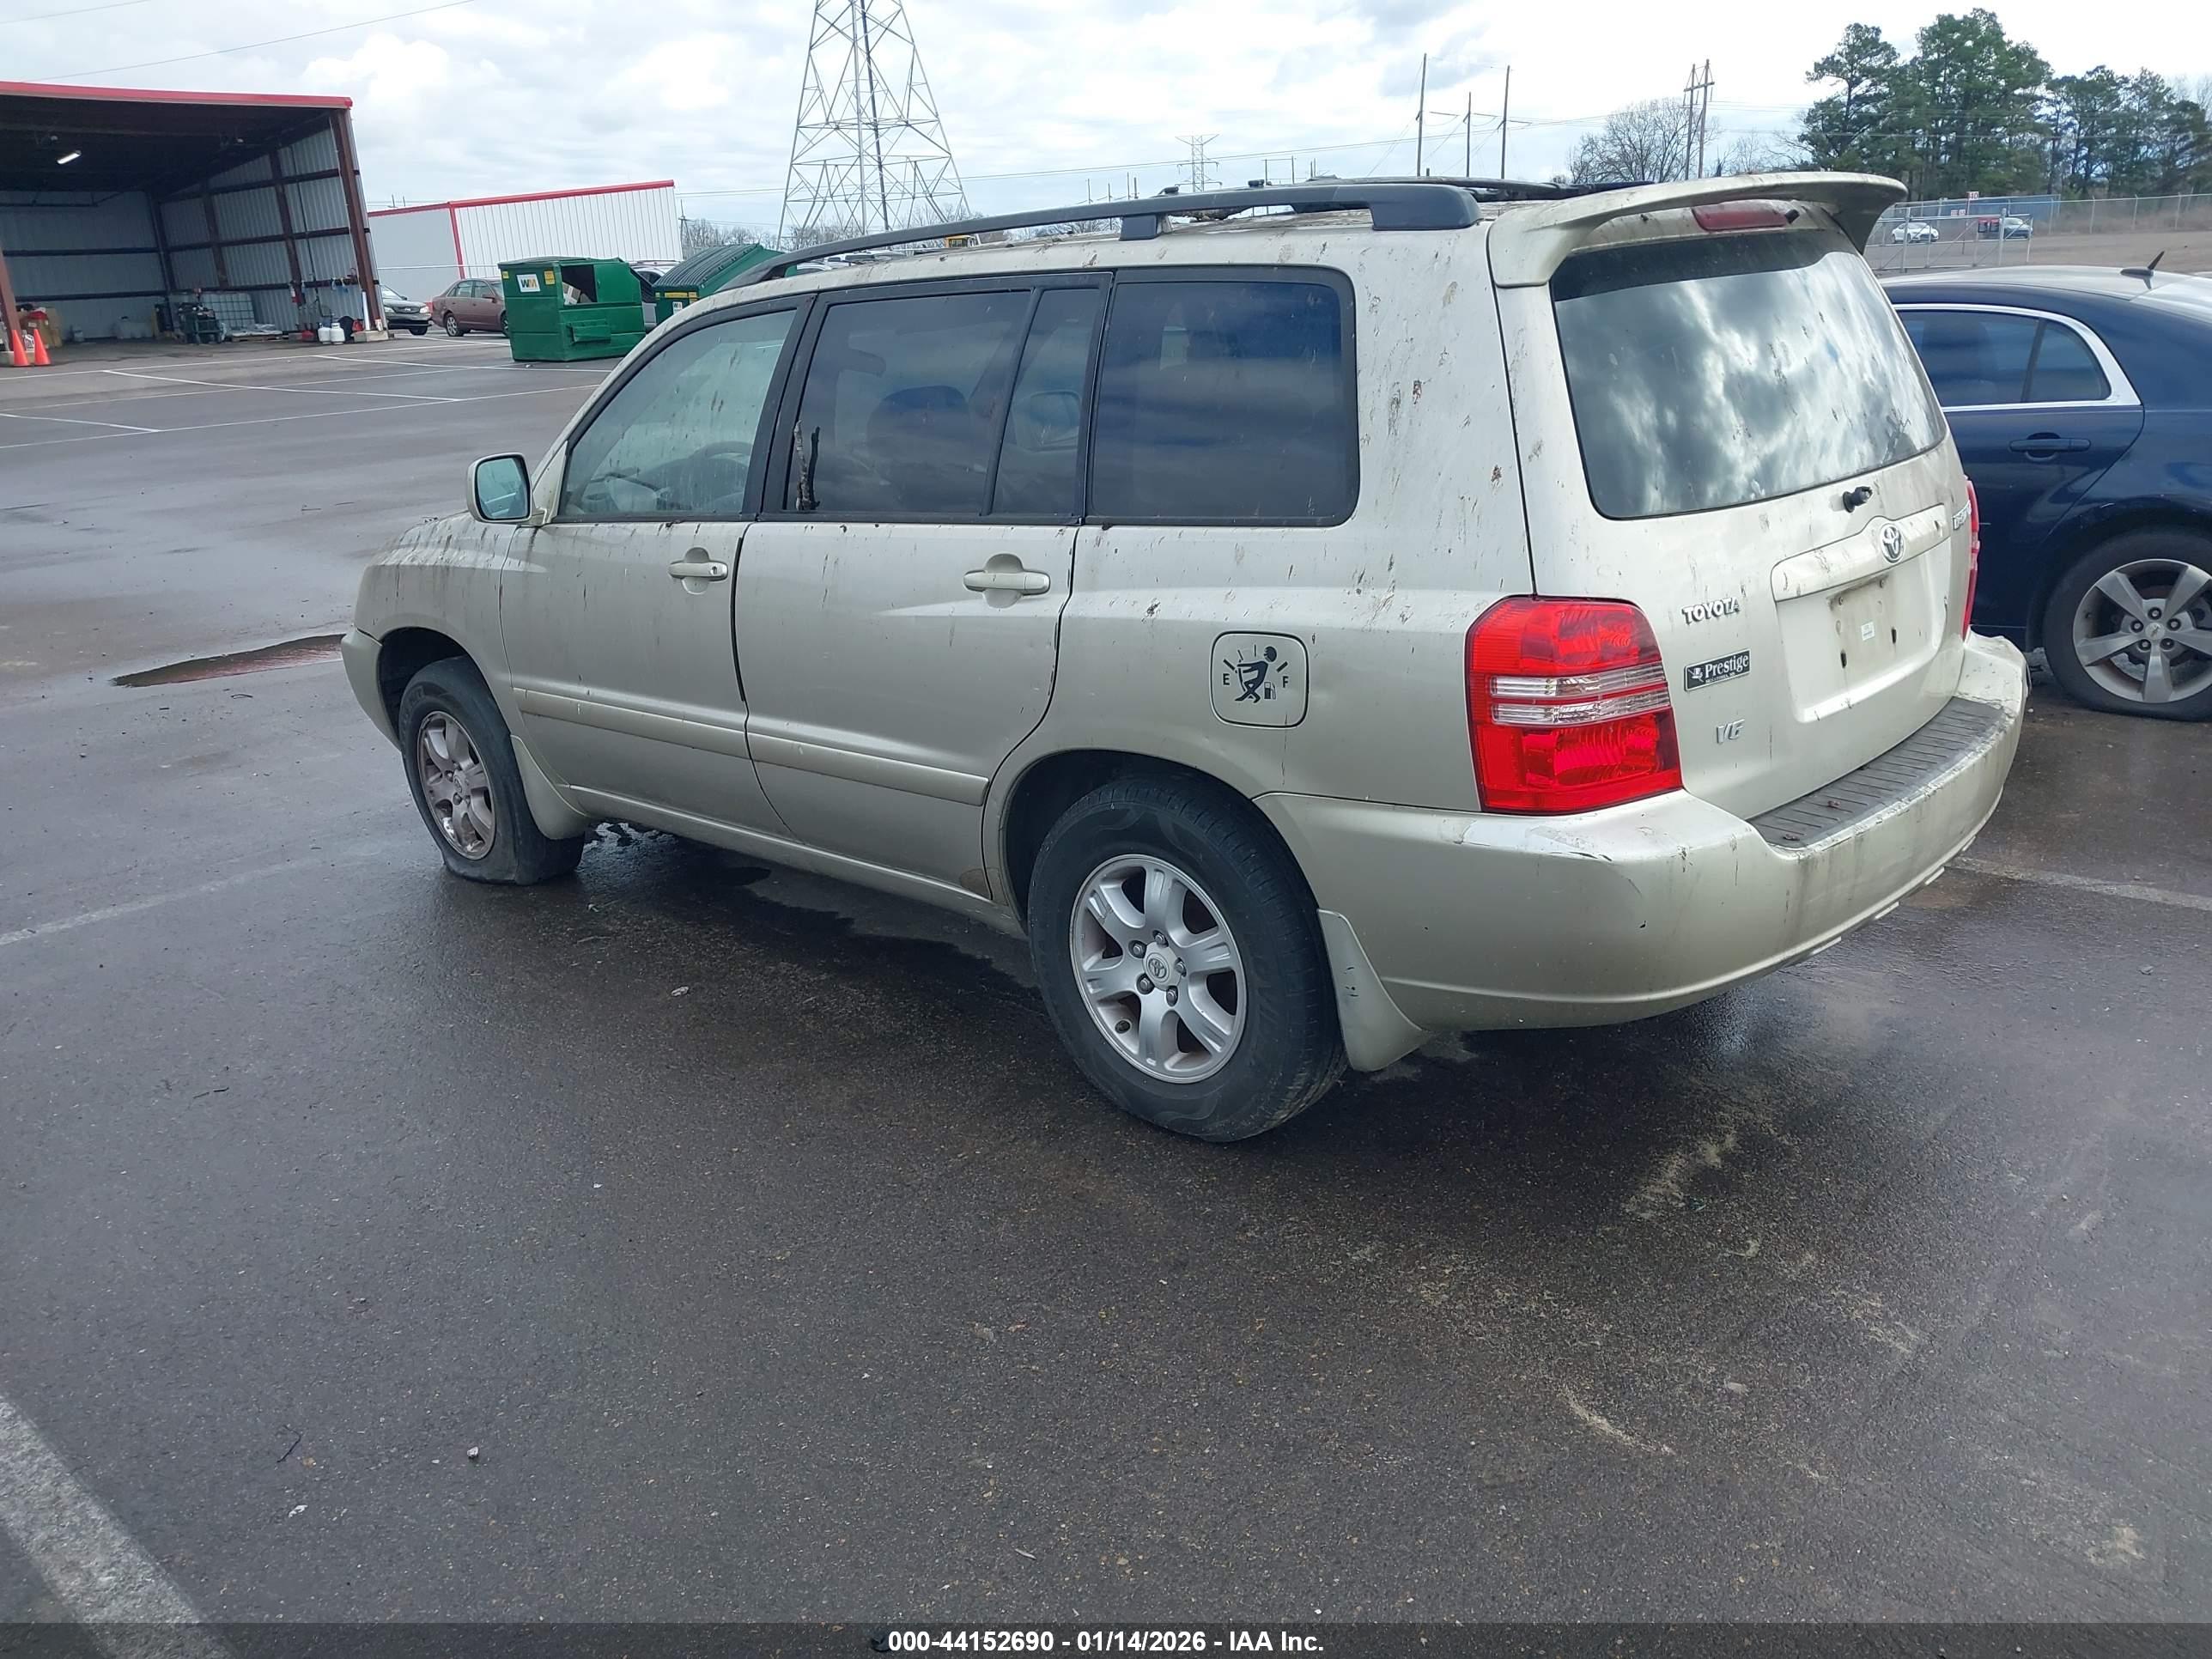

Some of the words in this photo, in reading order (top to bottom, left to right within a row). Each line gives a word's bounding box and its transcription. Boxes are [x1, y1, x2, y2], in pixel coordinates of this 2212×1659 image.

[520, 279, 537, 289] WM
[1682, 597, 1740, 625] TOYOTA
[1705, 654, 1749, 679] Prestige
[1223, 673, 1230, 685] E
[1282, 676, 1289, 688] F
[1717, 719, 1745, 744] V6
